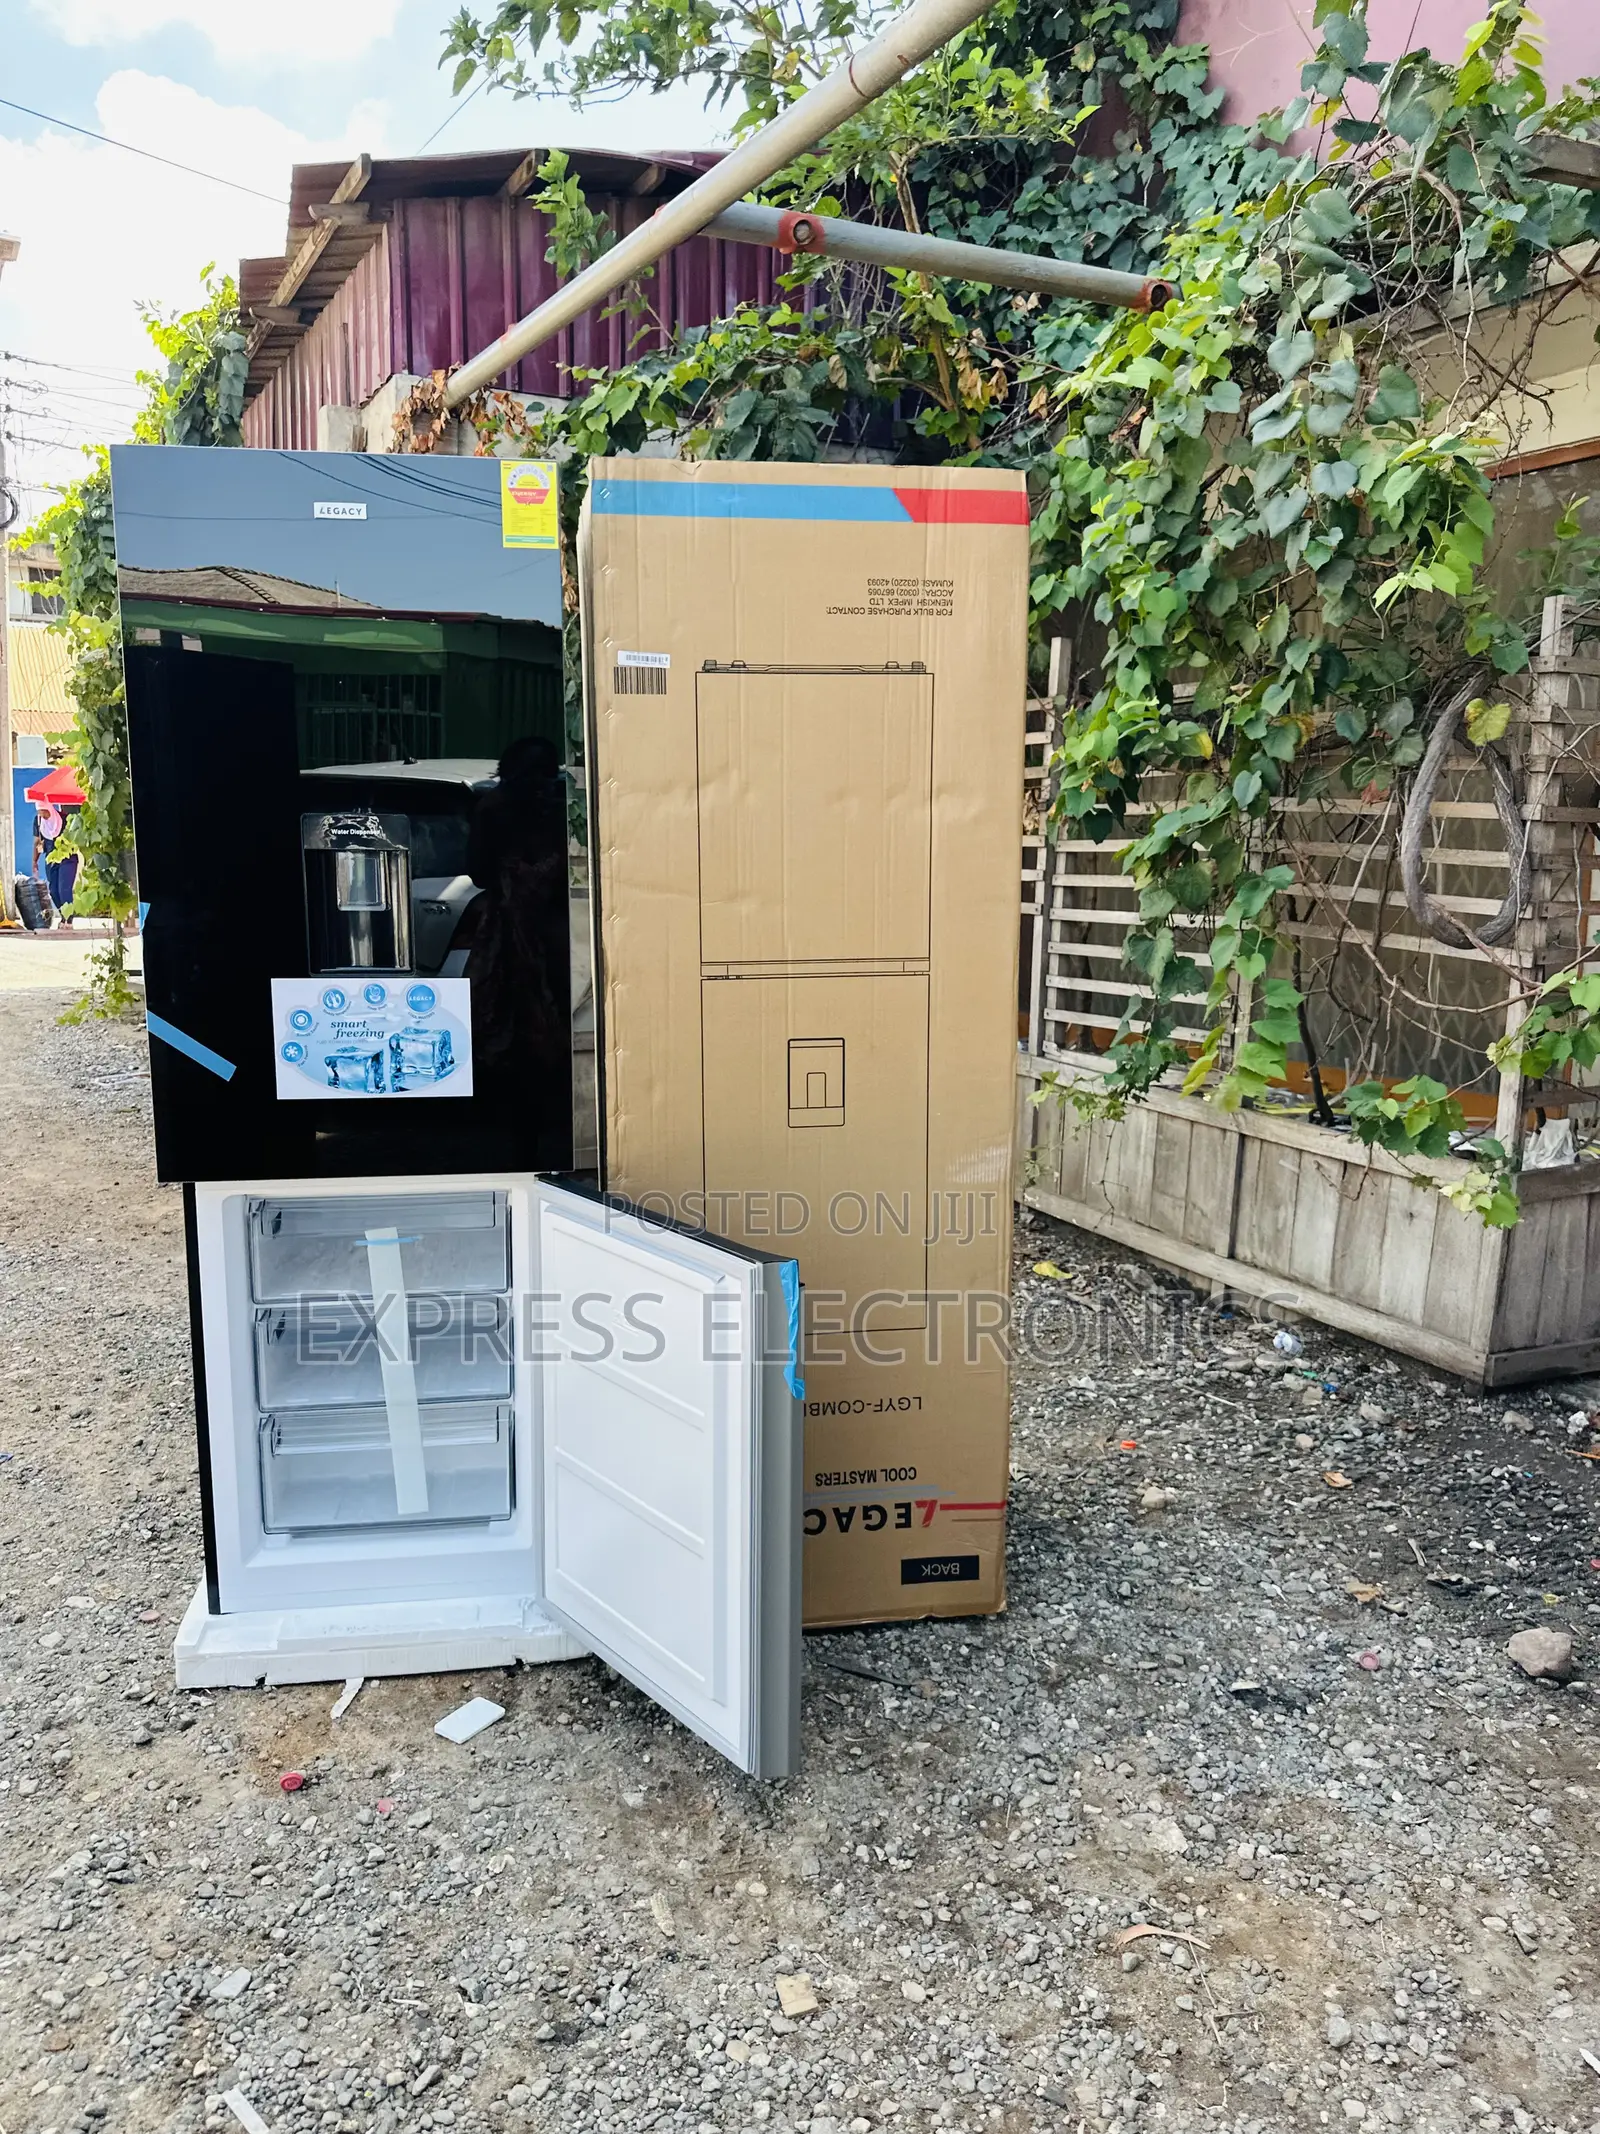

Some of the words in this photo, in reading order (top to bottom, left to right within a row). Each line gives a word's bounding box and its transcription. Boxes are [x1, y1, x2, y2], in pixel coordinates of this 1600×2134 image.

[319, 507, 362, 515] LEGACY
[867, 578, 890, 587] 42093
[891, 578, 919, 588] (03220)
[896, 588, 920, 597] (0302)
[869, 598, 884, 606] LTD
[888, 598, 913, 606] IMPEX
[917, 598, 953, 606] MENKISH
[826, 606, 866, 615] CONTACT:
[867, 607, 911, 616] PURCHASE
[913, 608, 934, 616] BULK
[936, 608, 953, 616] FOR
[330, 1020, 368, 1028] smart
[333, 1028, 385, 1040] freezing
[815, 1469, 877, 1487] MASTERS
[880, 1466, 917, 1481] COOL
[921, 1562, 960, 1576] BACK
